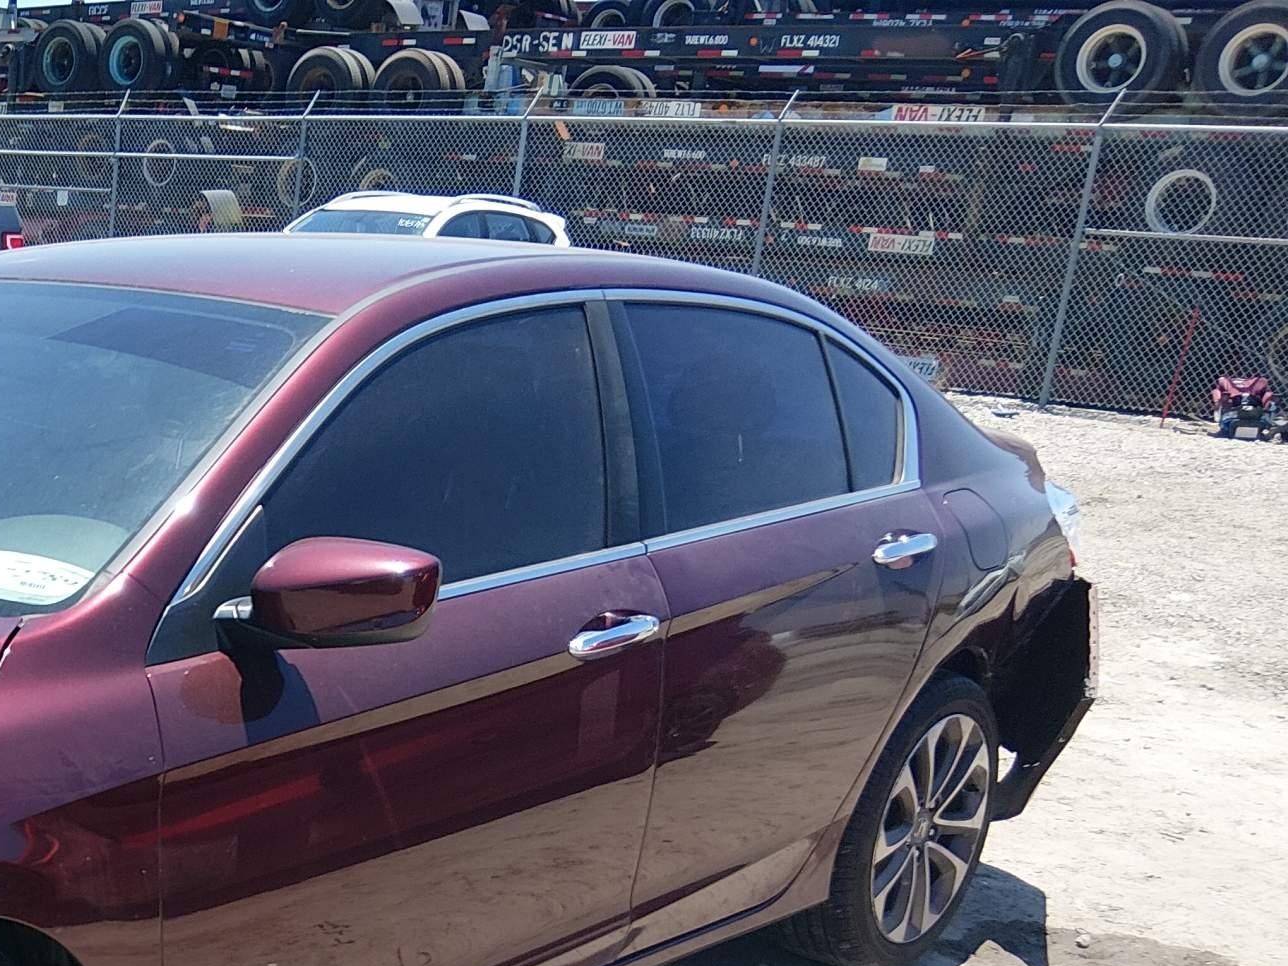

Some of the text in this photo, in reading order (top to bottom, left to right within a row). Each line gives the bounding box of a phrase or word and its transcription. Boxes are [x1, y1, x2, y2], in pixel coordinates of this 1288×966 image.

[581, 33, 634, 47] FLEXI-VAN
[781, 34, 840, 47] FLXZ 414321
[893, 105, 983, 121] FLEXI-VAN
[763, 153, 786, 167] FLZ
[870, 236, 933, 253] FLEXI-VAN
